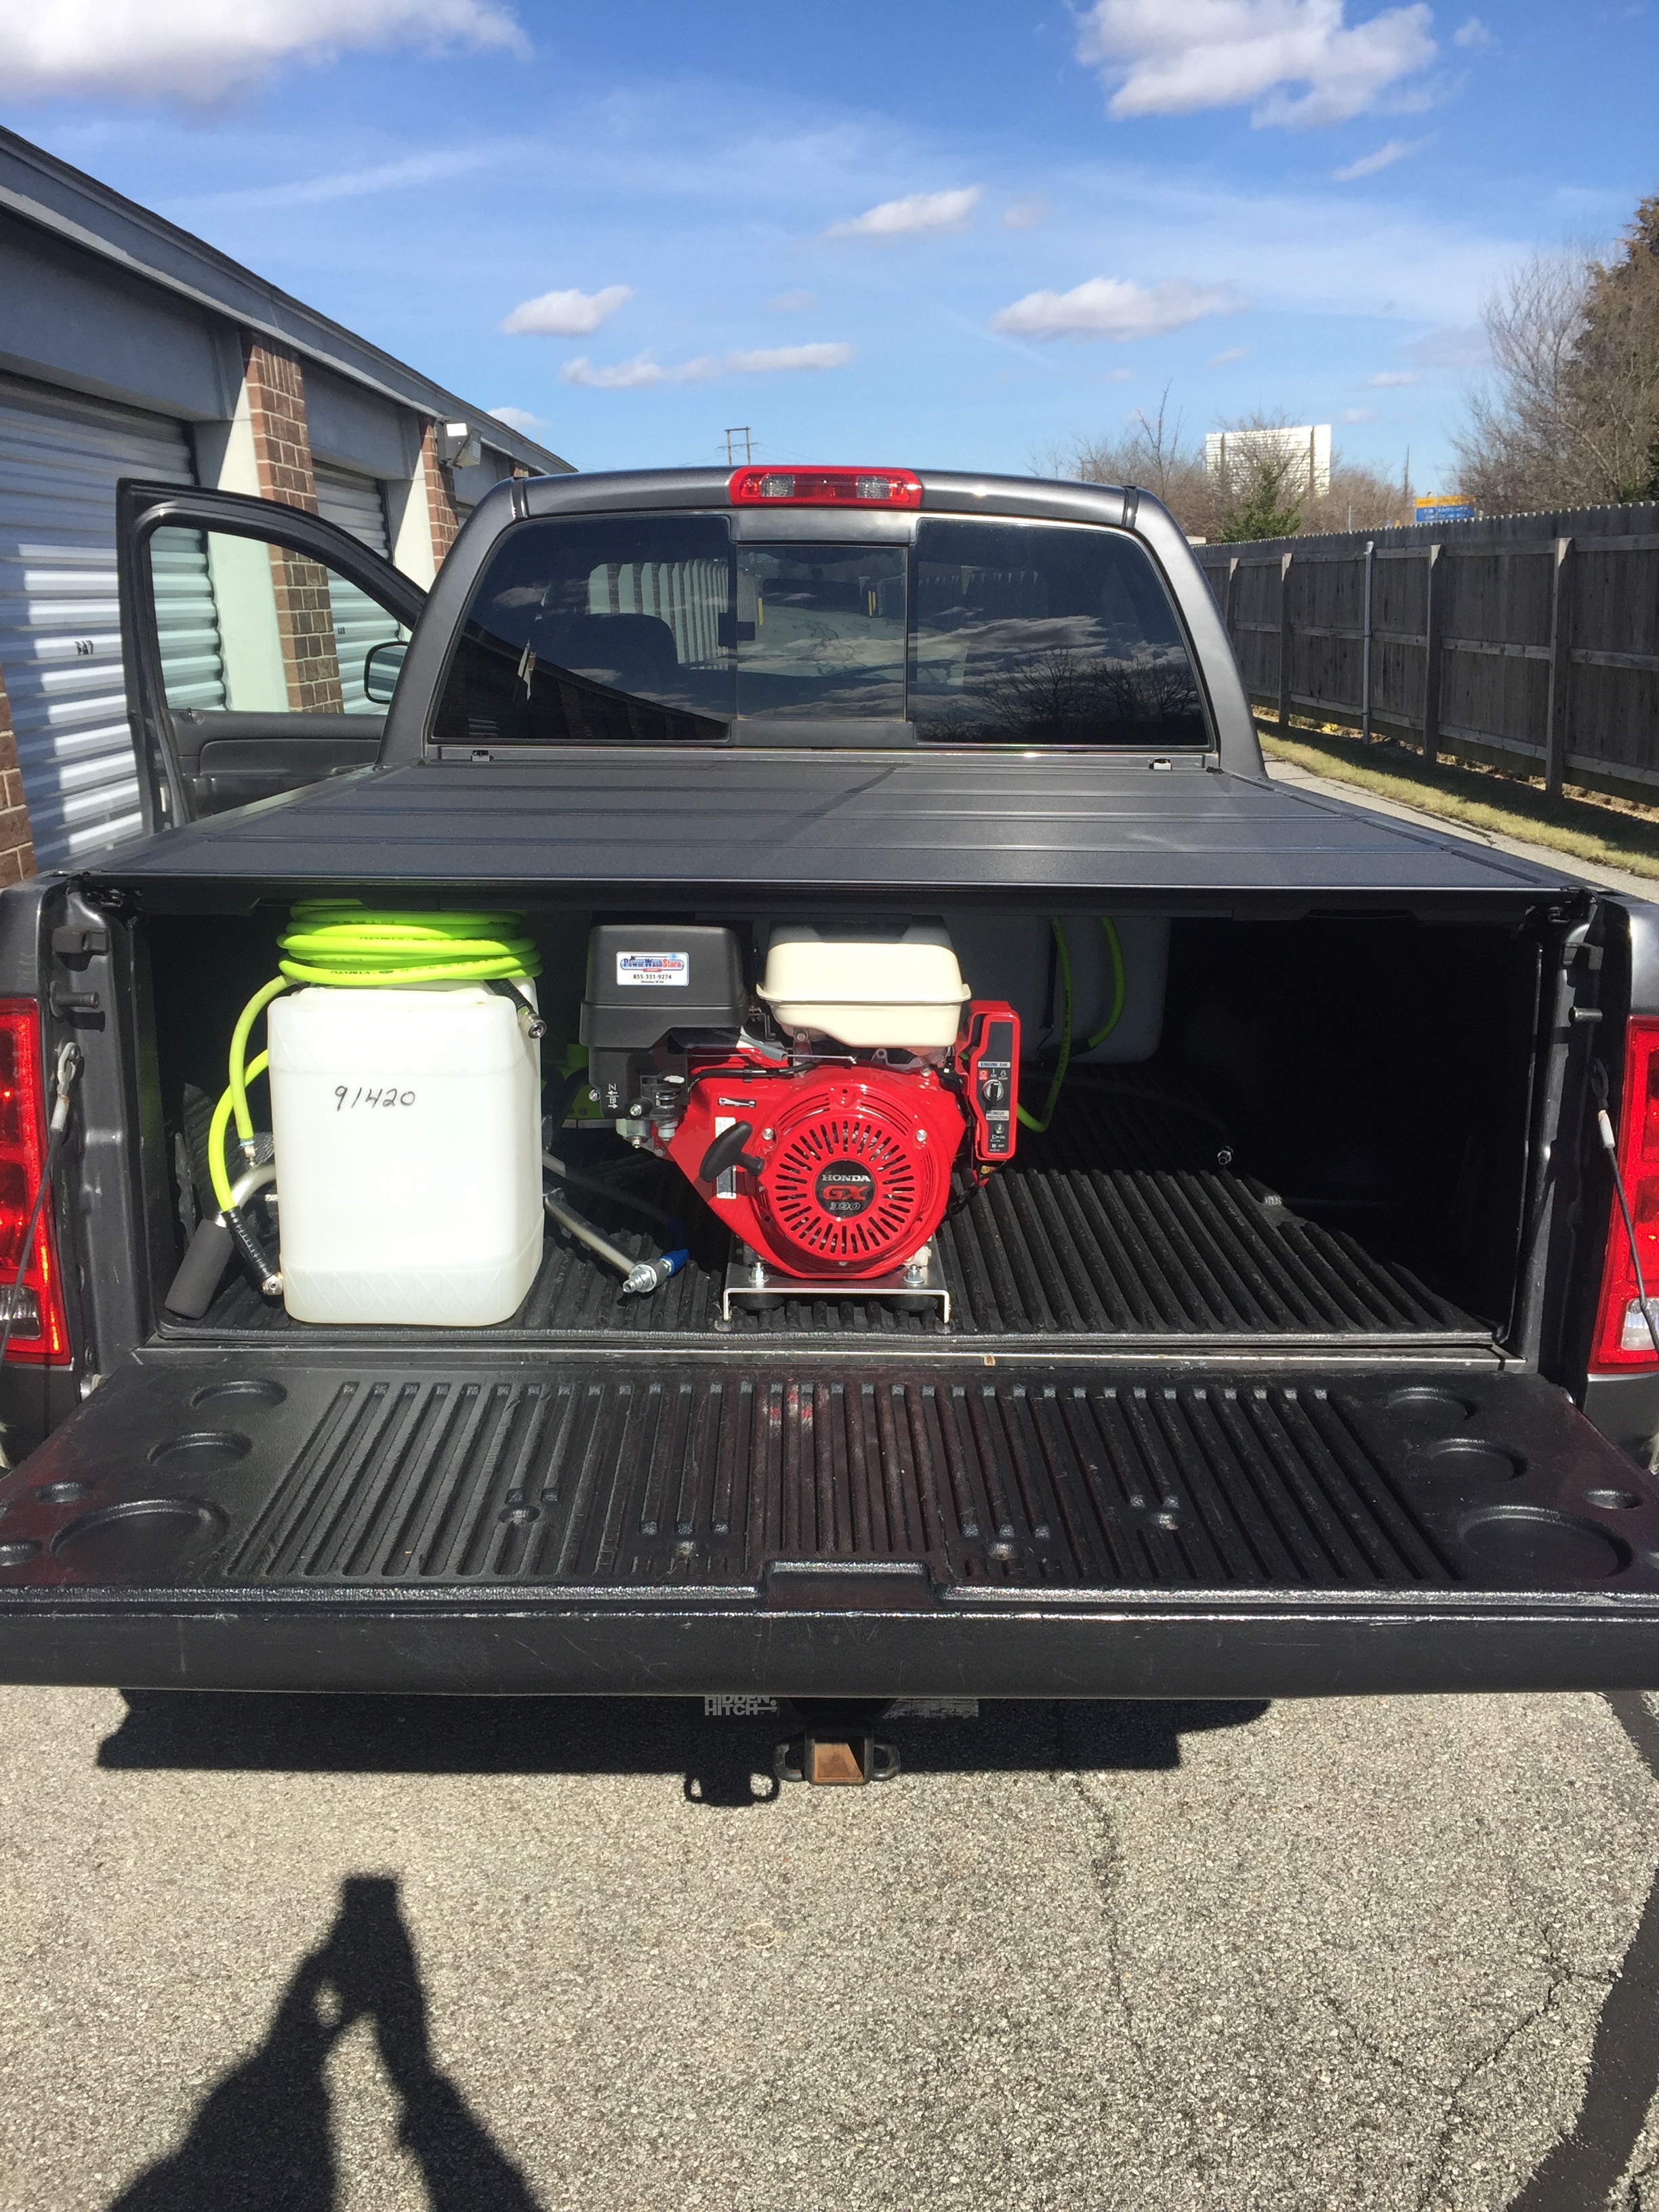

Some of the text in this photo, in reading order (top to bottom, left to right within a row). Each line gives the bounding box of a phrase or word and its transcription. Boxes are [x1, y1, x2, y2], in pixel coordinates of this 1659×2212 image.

[335, 1086, 415, 1111] 91420
[823, 1185, 868, 1200] GX
[830, 1202, 861, 1210] 390
[705, 1704, 758, 1716] HITCH
